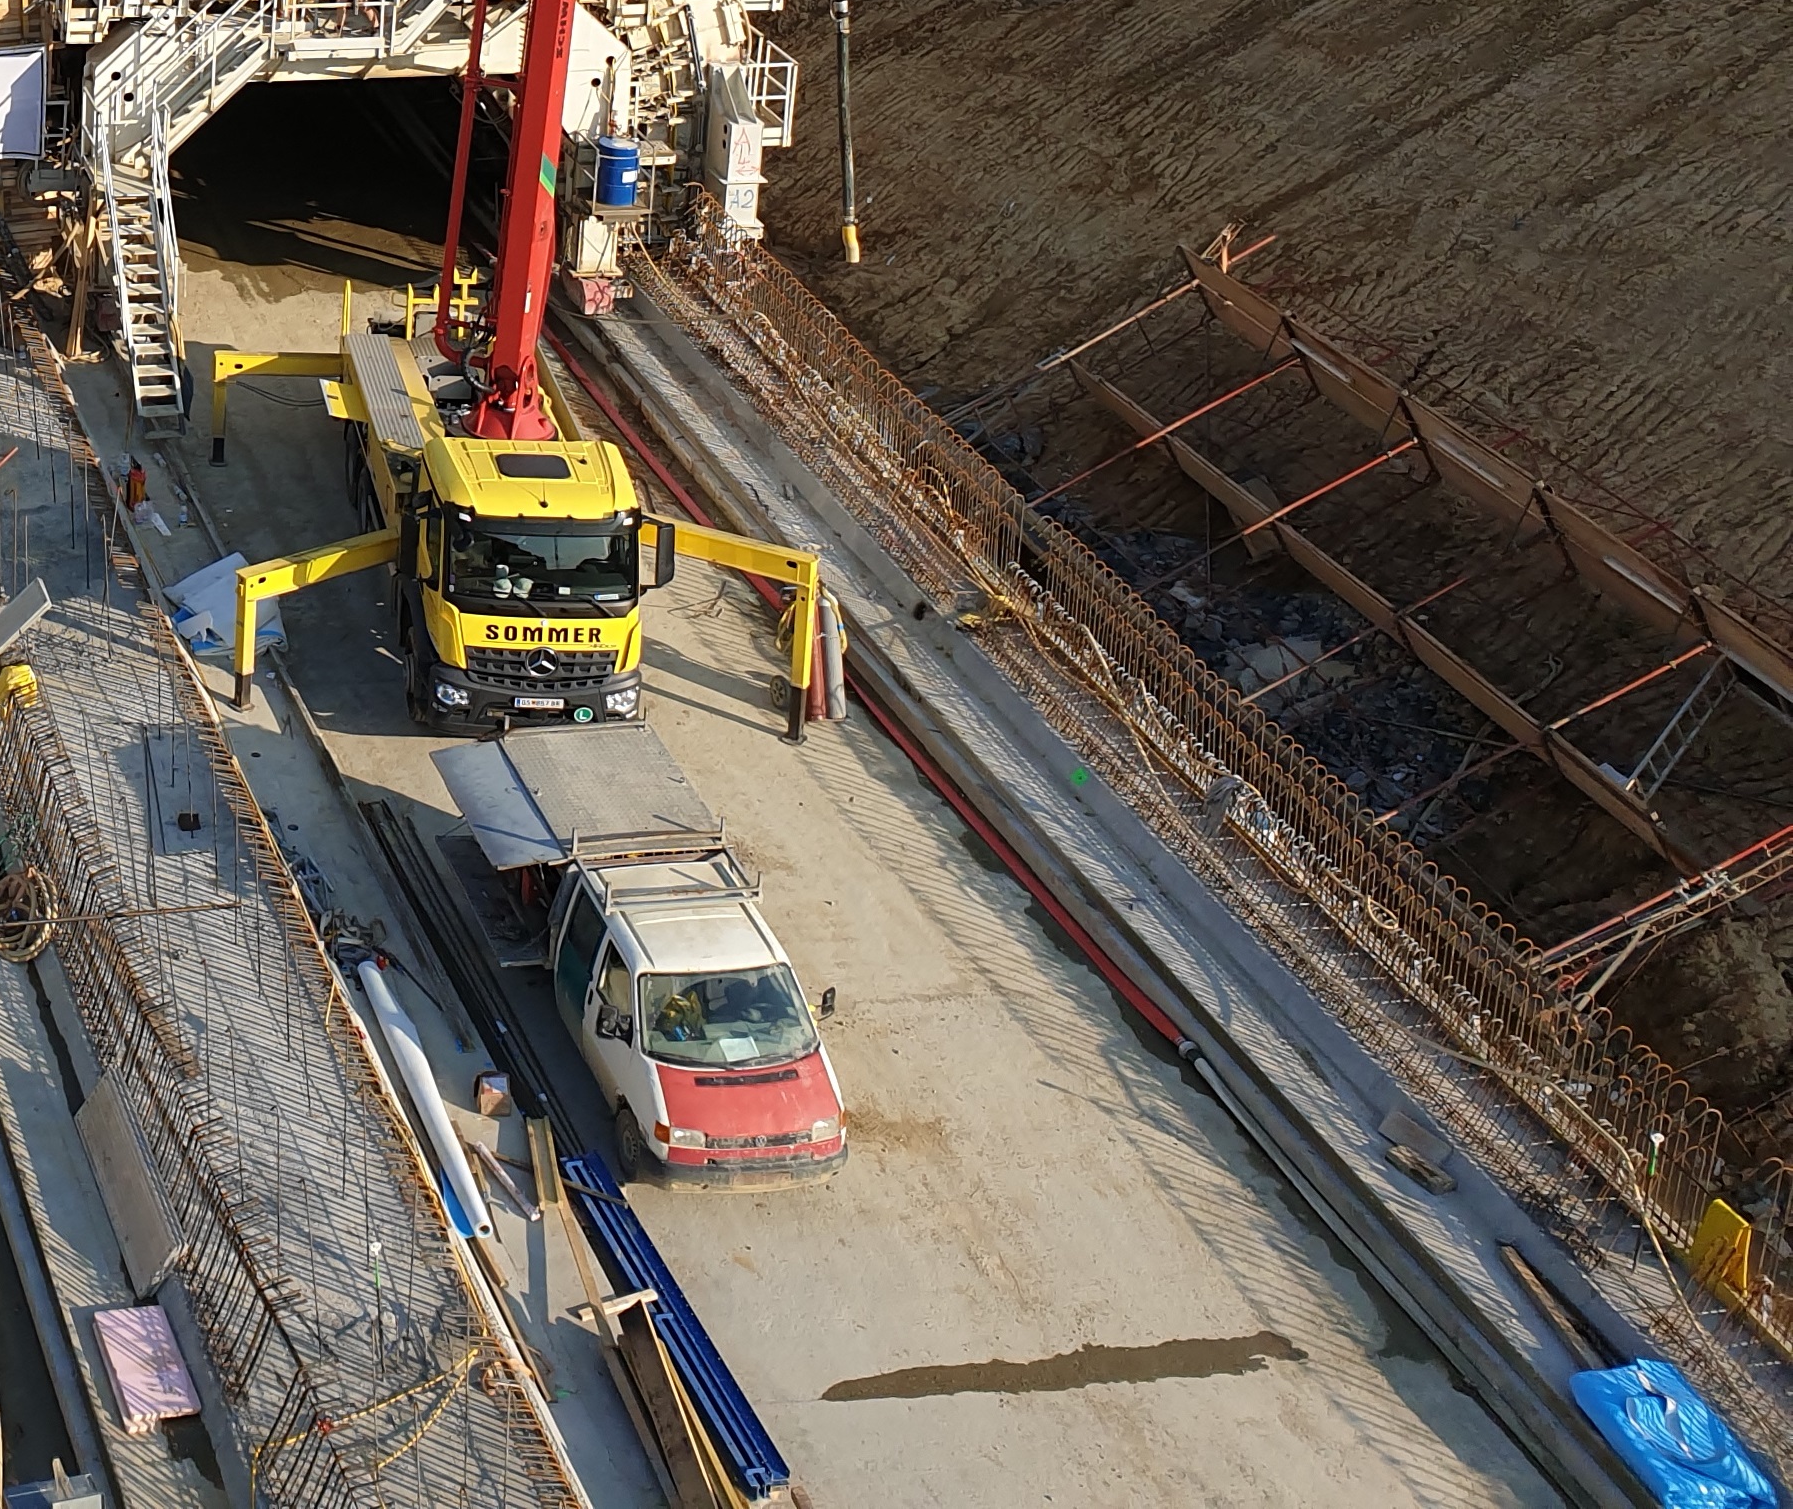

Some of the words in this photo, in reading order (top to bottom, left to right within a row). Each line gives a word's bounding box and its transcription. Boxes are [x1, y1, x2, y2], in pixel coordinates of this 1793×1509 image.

[729, 189, 755, 210] A2
[485, 624, 602, 643] SOMMER
[579, 710, 587, 720] L
